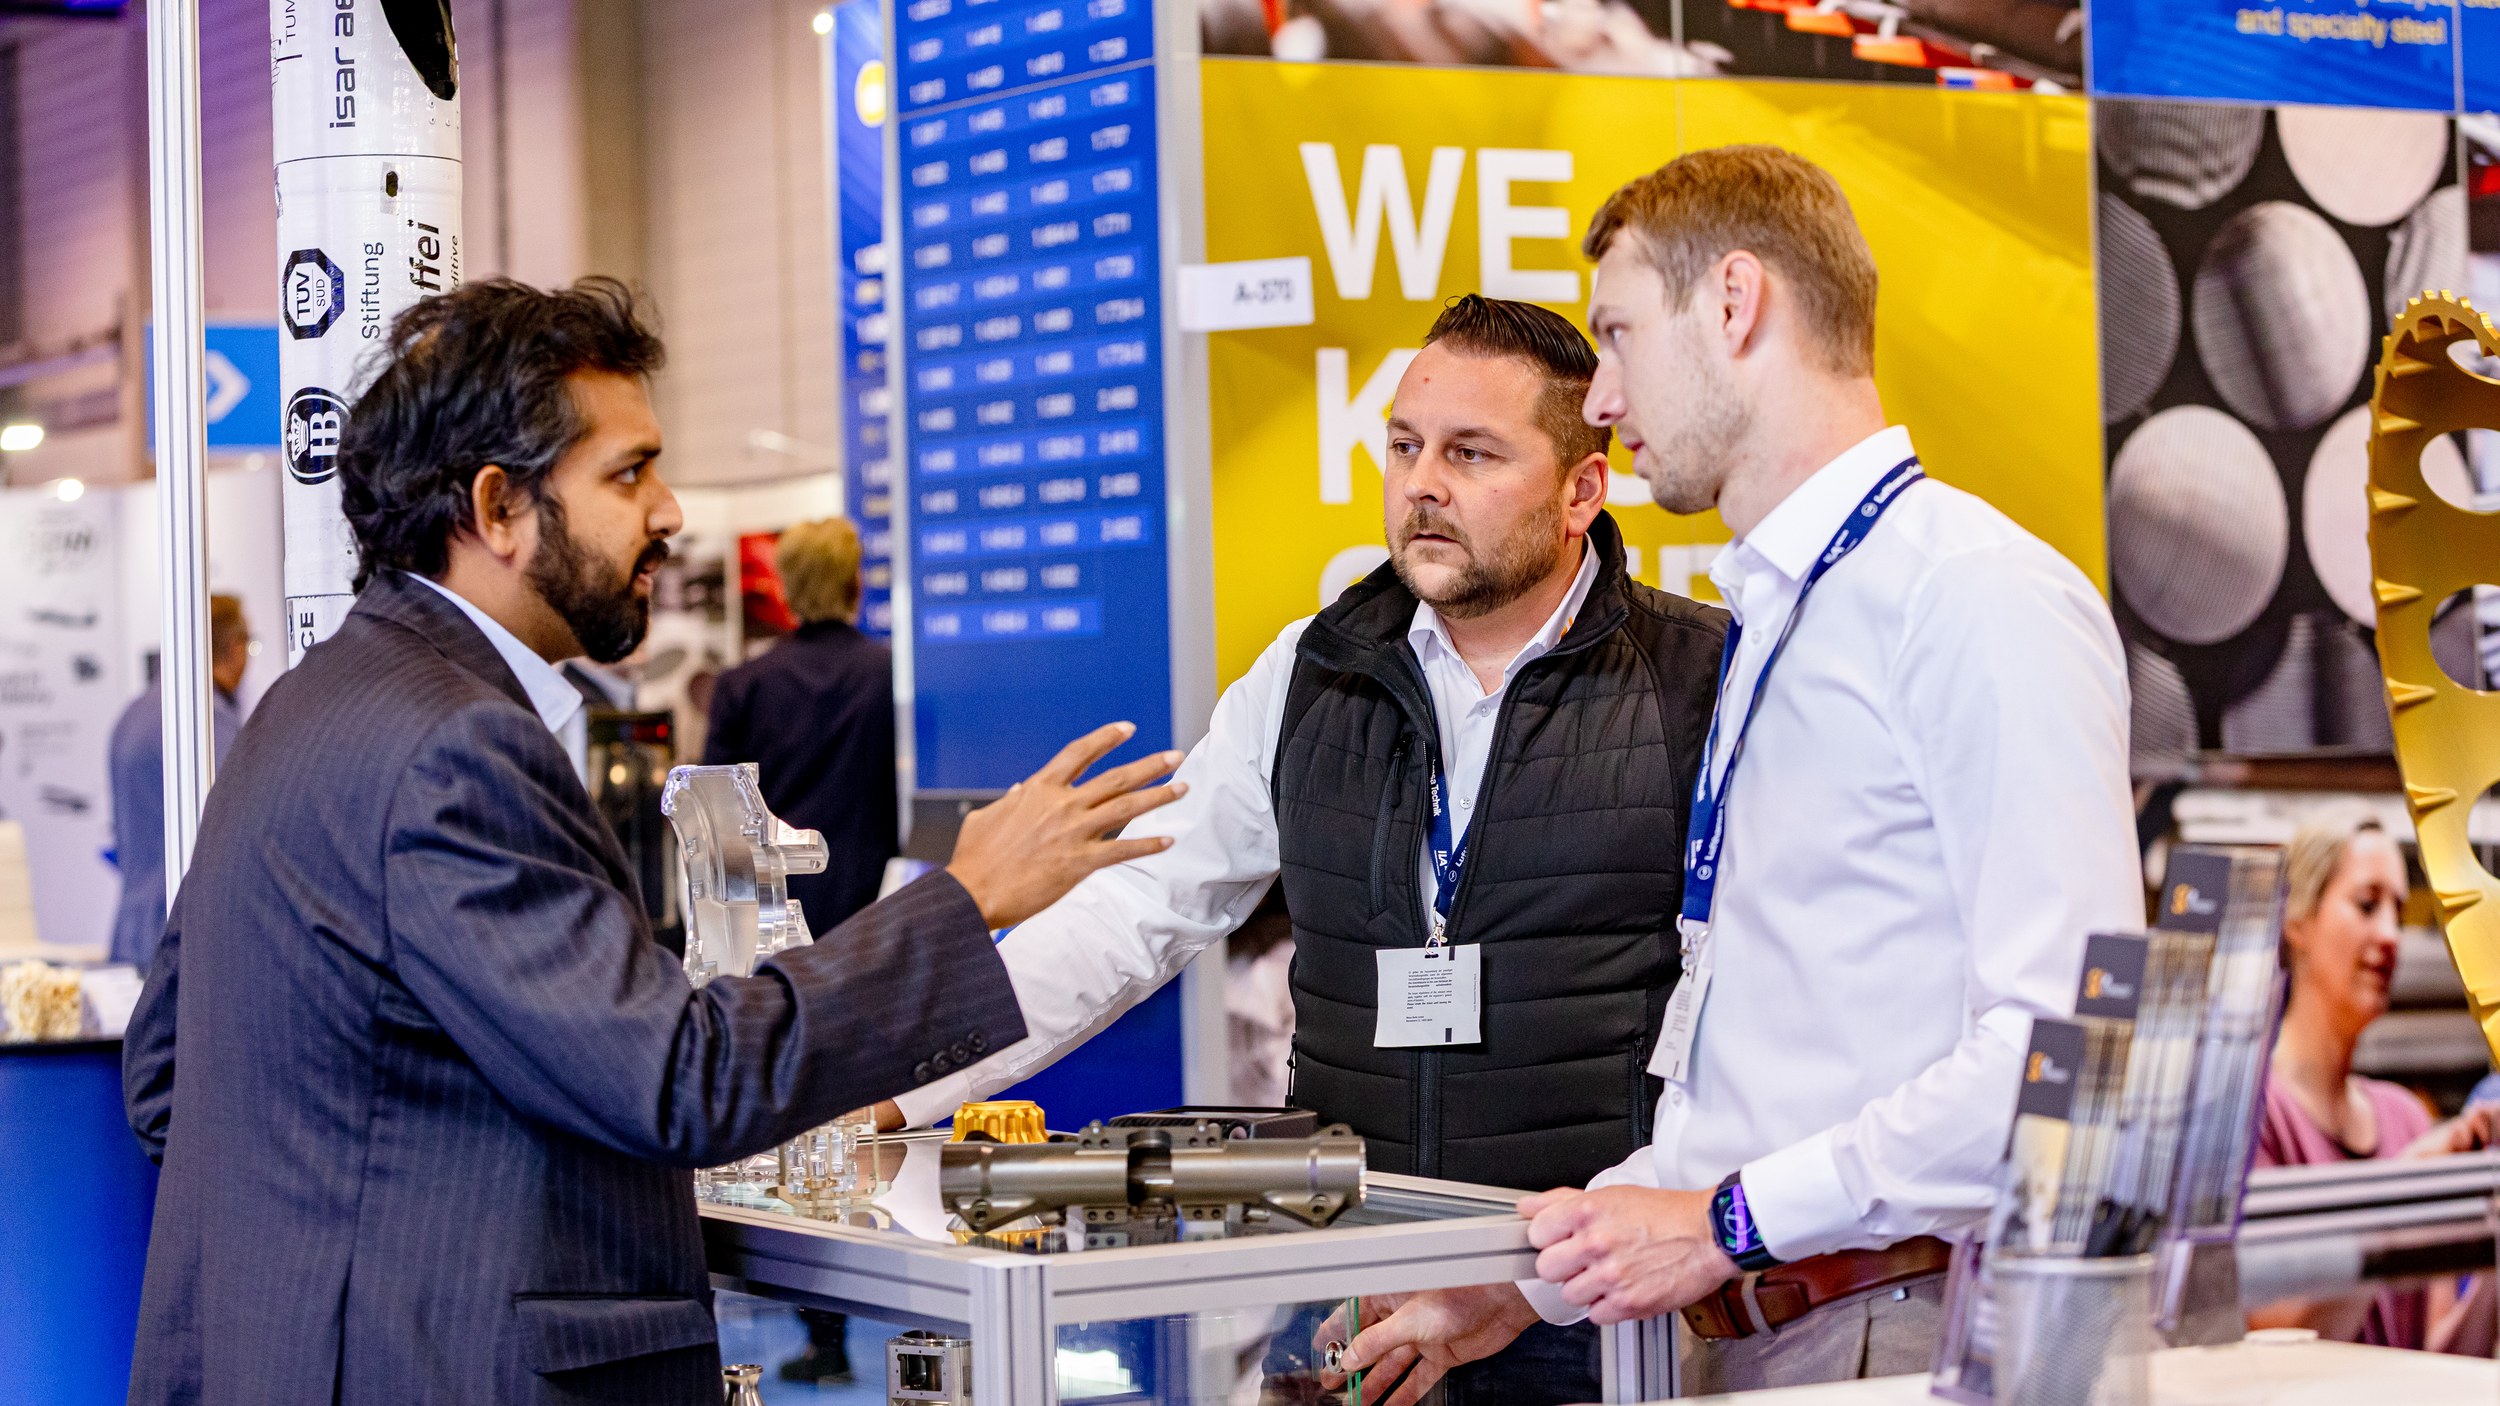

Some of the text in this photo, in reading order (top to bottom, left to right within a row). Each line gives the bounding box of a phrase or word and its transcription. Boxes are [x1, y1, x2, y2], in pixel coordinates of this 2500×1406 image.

[330, 47, 356, 128] isar
[407, 219, 441, 304] ffei
[450, 235, 460, 290] ditive
[1299, 142, 1581, 302] WE
[296, 271, 311, 320] TÜV
[361, 241, 385, 340] Stiftung
[1431, 785, 1442, 817] Technik
